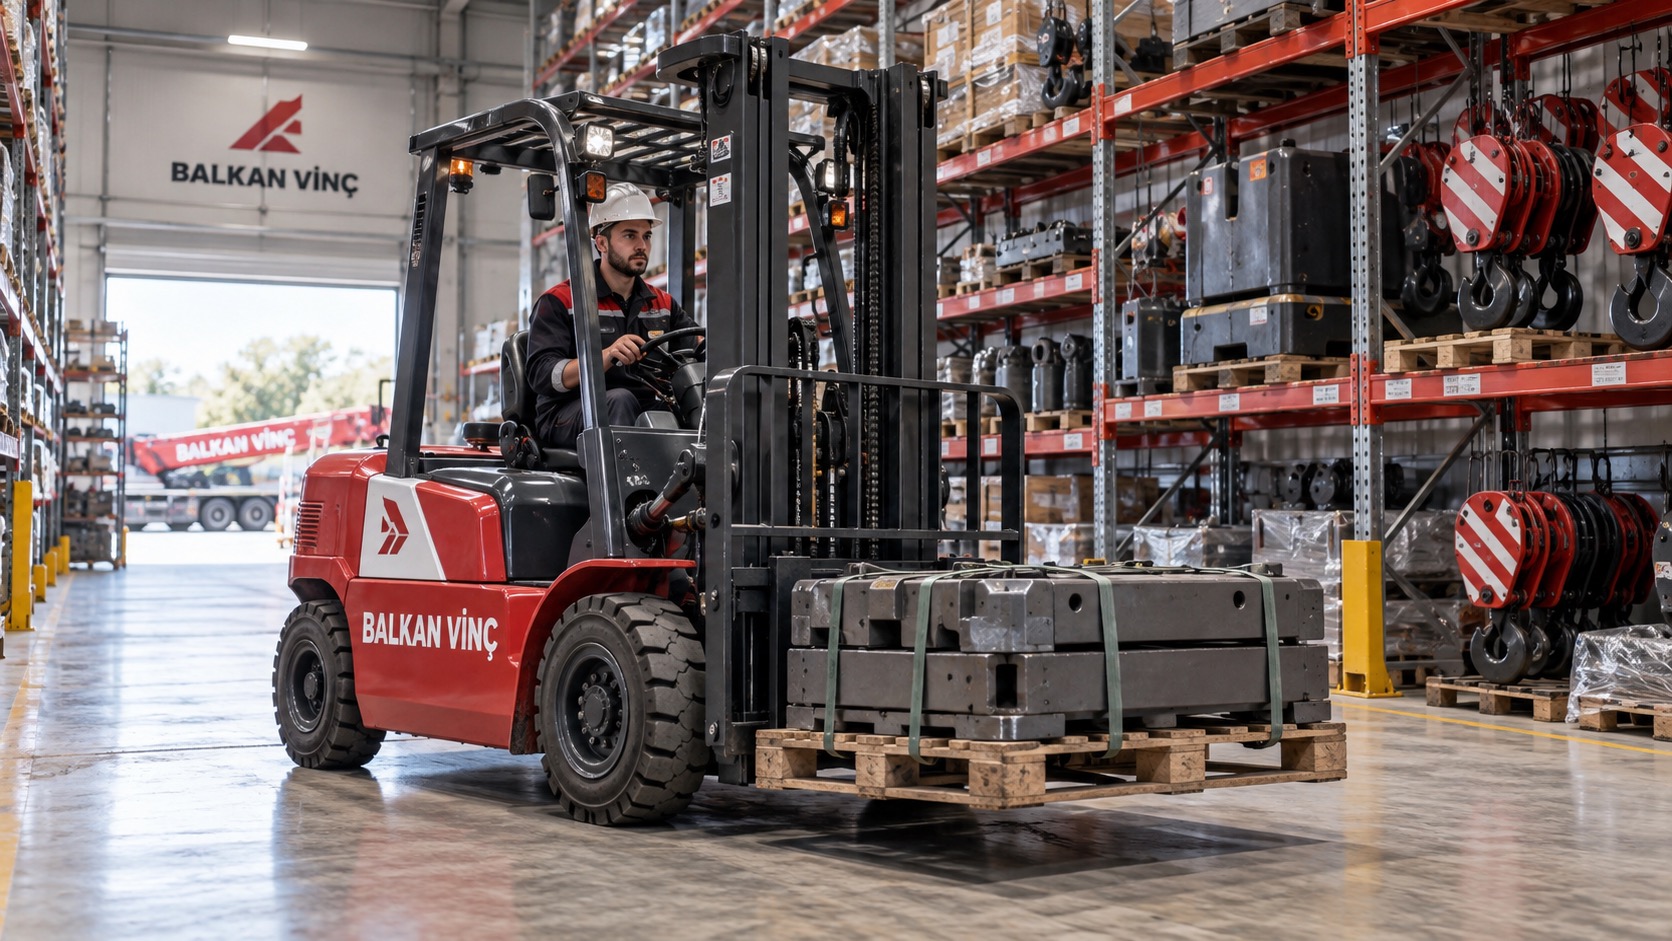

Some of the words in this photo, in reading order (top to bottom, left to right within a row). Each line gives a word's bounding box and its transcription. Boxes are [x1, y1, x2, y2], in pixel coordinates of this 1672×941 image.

[171, 162, 286, 189] BALKAN
[293, 166, 359, 198] VİNÇ
[175, 434, 249, 463] BALKAN
[362, 611, 442, 649] BALKAN
[446, 607, 499, 662] VİNÇ
